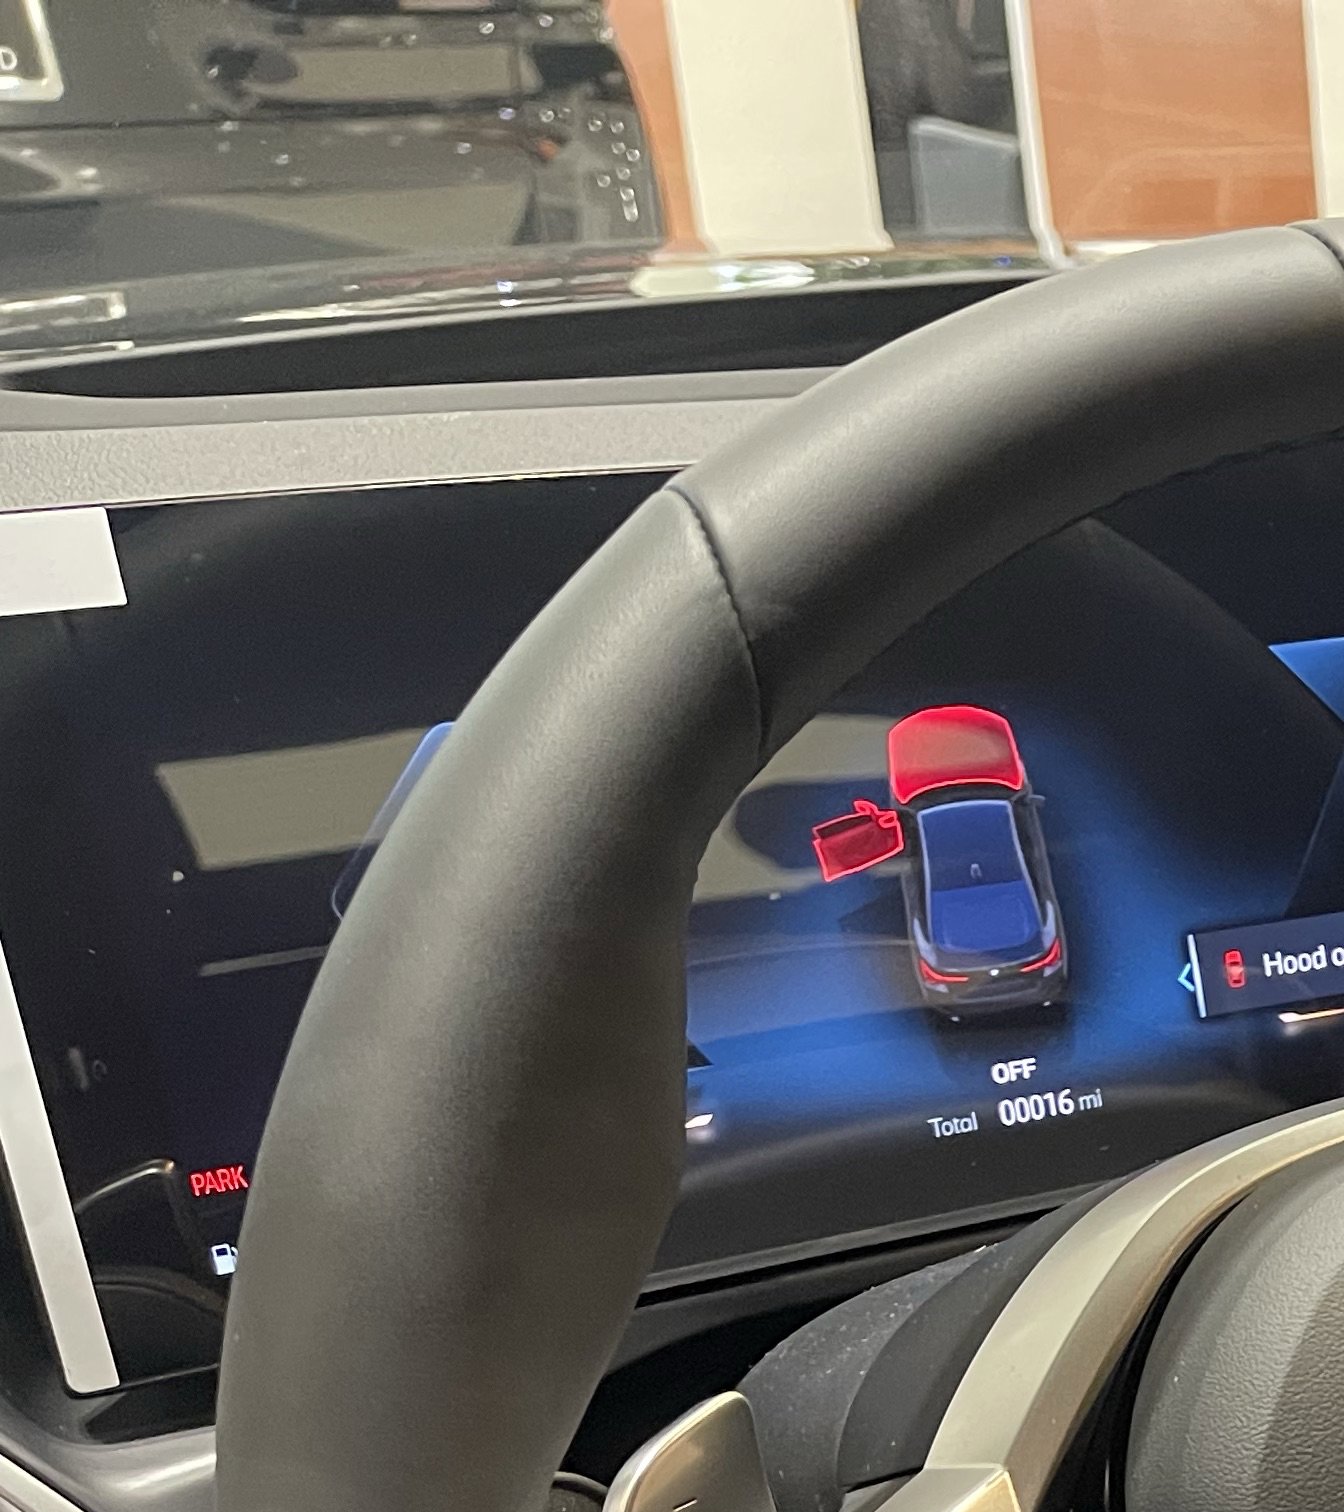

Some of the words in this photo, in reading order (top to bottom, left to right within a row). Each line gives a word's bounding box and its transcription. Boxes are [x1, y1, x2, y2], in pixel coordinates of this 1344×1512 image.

[1262, 944, 1328, 978] Hood
[990, 1057, 1038, 1085] OFF
[926, 1111, 980, 1138] Total
[998, 1088, 1075, 1127] 00016
[1078, 1088, 1104, 1112] mi
[190, 1165, 249, 1197] PARK
